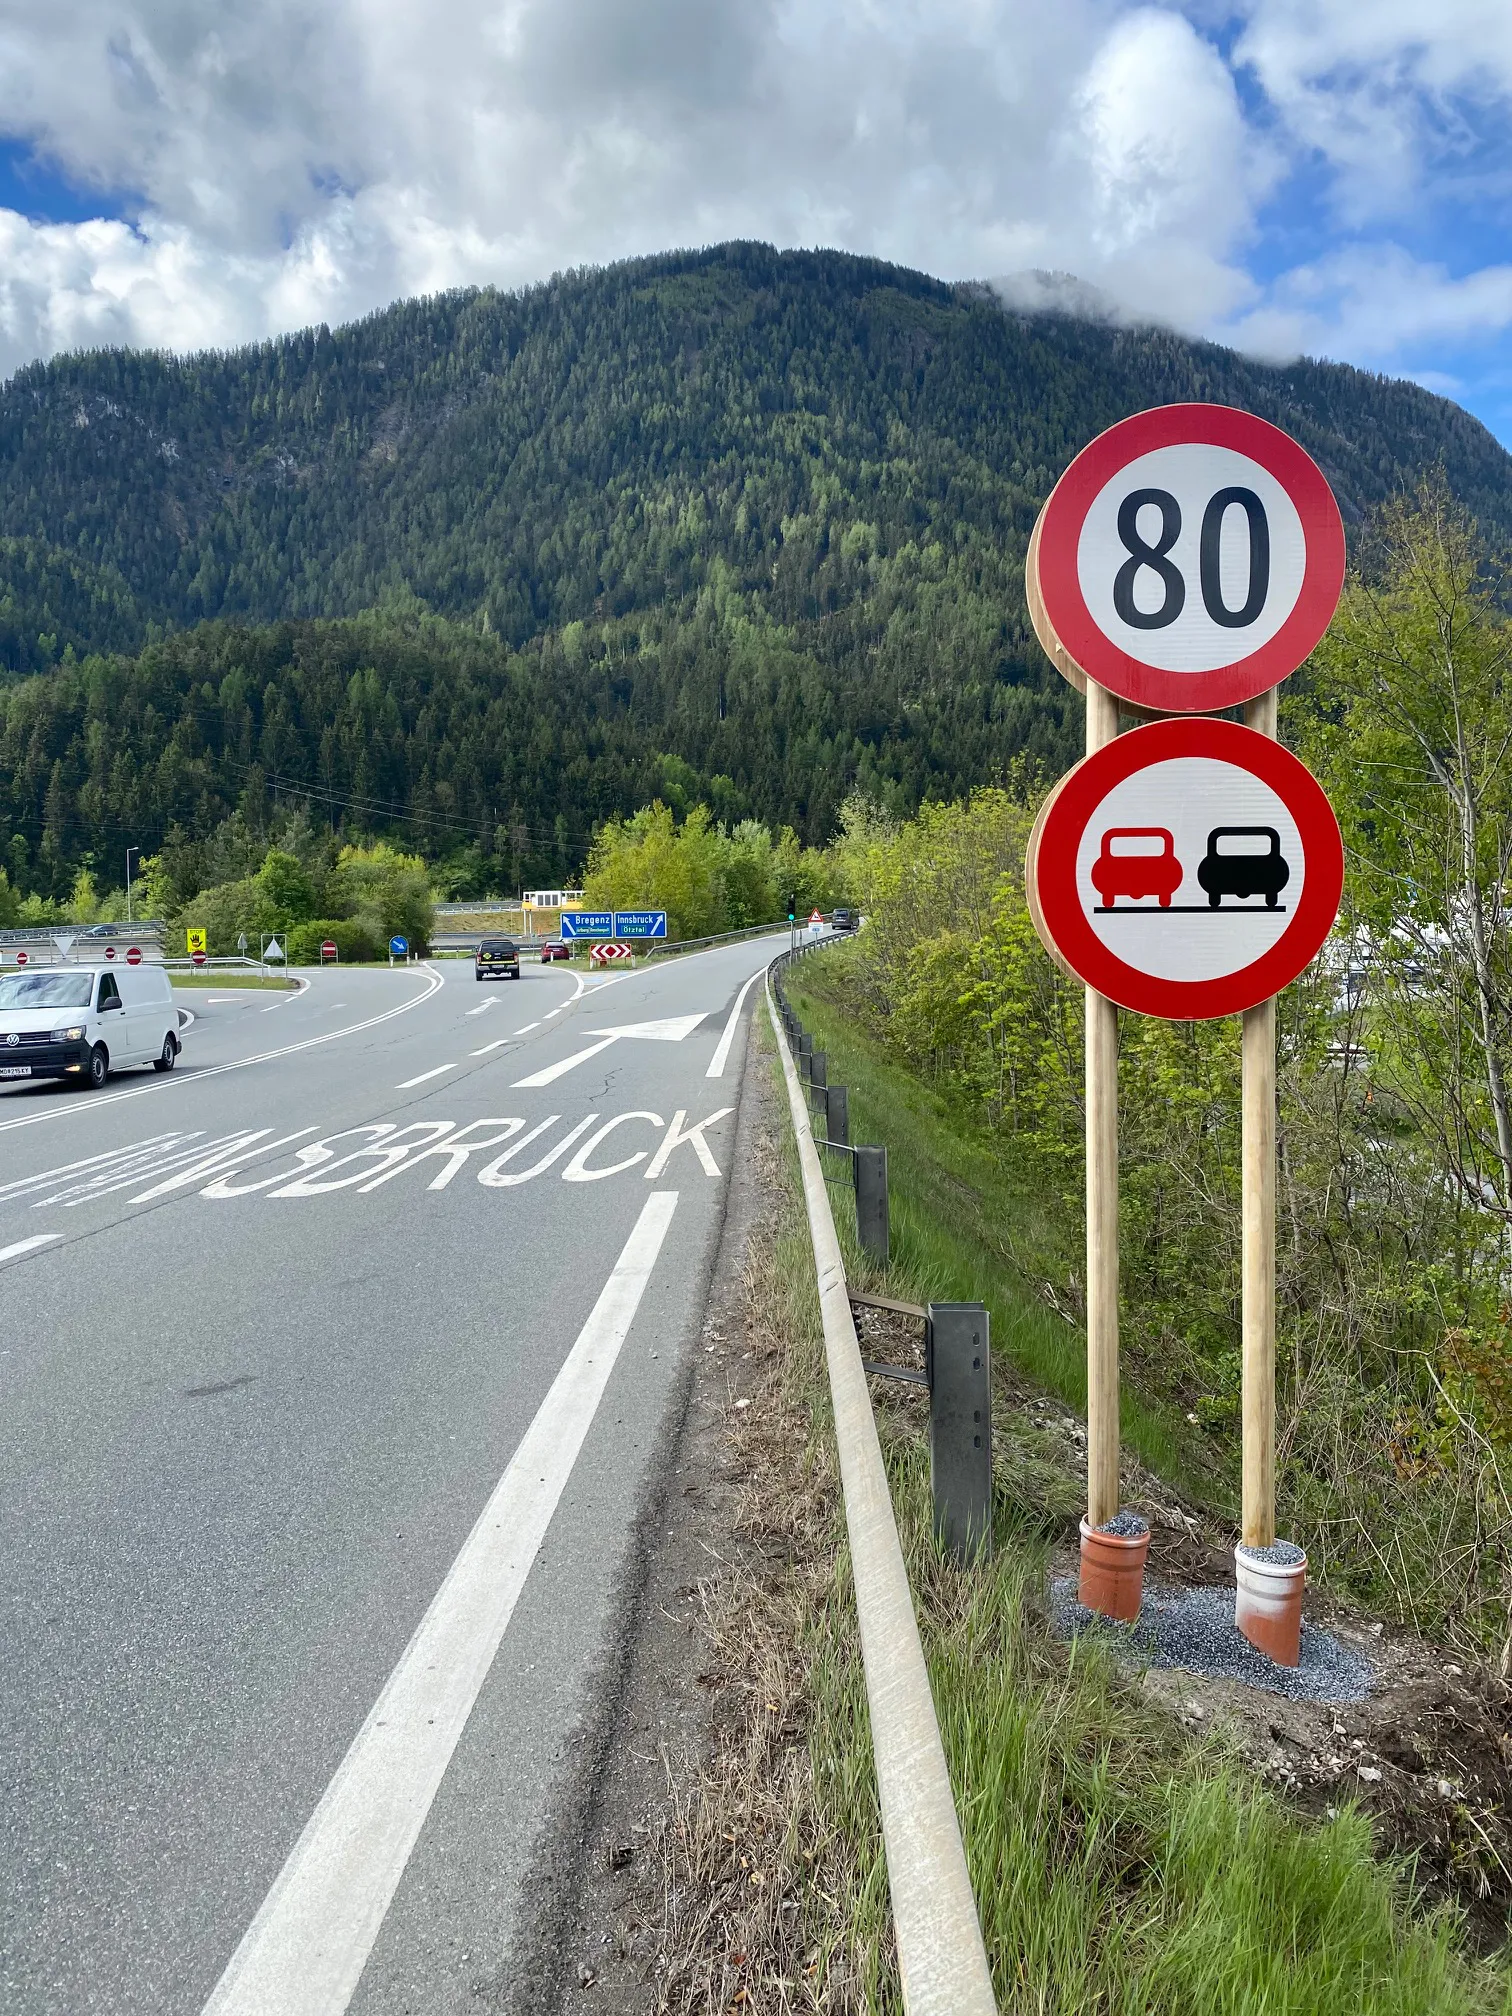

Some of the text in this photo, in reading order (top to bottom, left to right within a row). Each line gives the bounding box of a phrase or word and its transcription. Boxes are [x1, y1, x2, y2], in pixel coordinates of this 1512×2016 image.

[1114, 486, 1271, 630] 80
[575, 915, 610, 926] Bregenz
[617, 914, 654, 924] Innsbruck
[623, 925, 645, 933] Ötztal
[0, 1108, 736, 1213] INNSBRUCK
